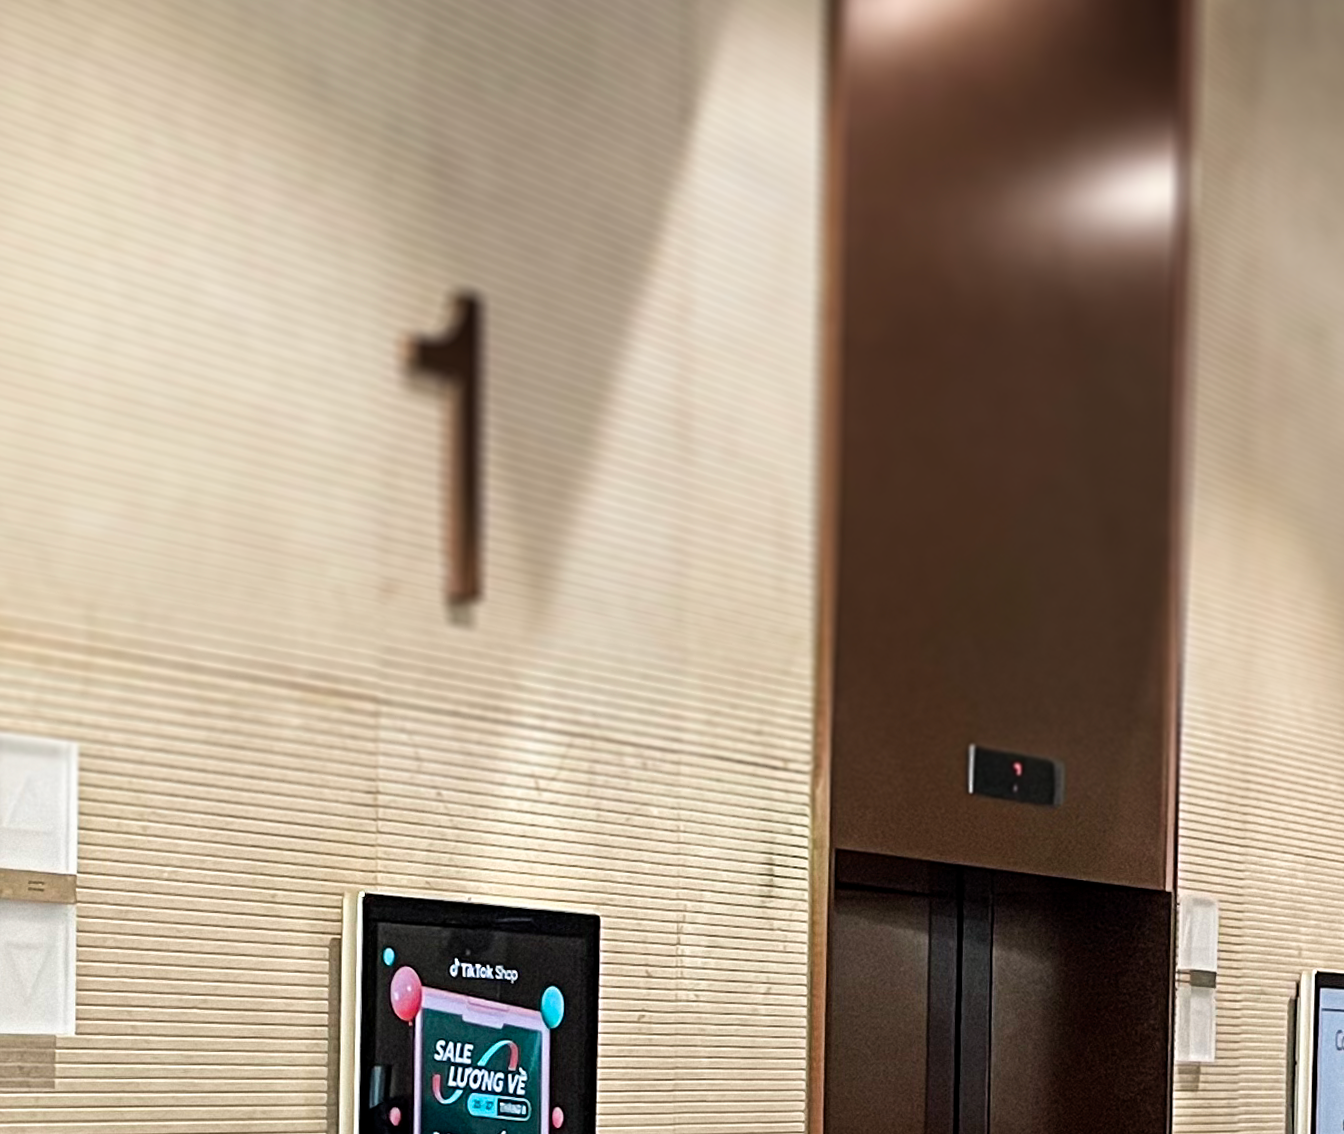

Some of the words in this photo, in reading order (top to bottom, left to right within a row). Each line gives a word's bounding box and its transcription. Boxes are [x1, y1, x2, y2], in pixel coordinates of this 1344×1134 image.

[400, 291, 484, 603] 1
[461, 963, 494, 979] TikTok
[495, 965, 518, 984] Shop
[434, 1039, 474, 1065] SALE
[447, 1065, 505, 1093] LƯƠNG
[508, 1067, 528, 1095] VỀ
